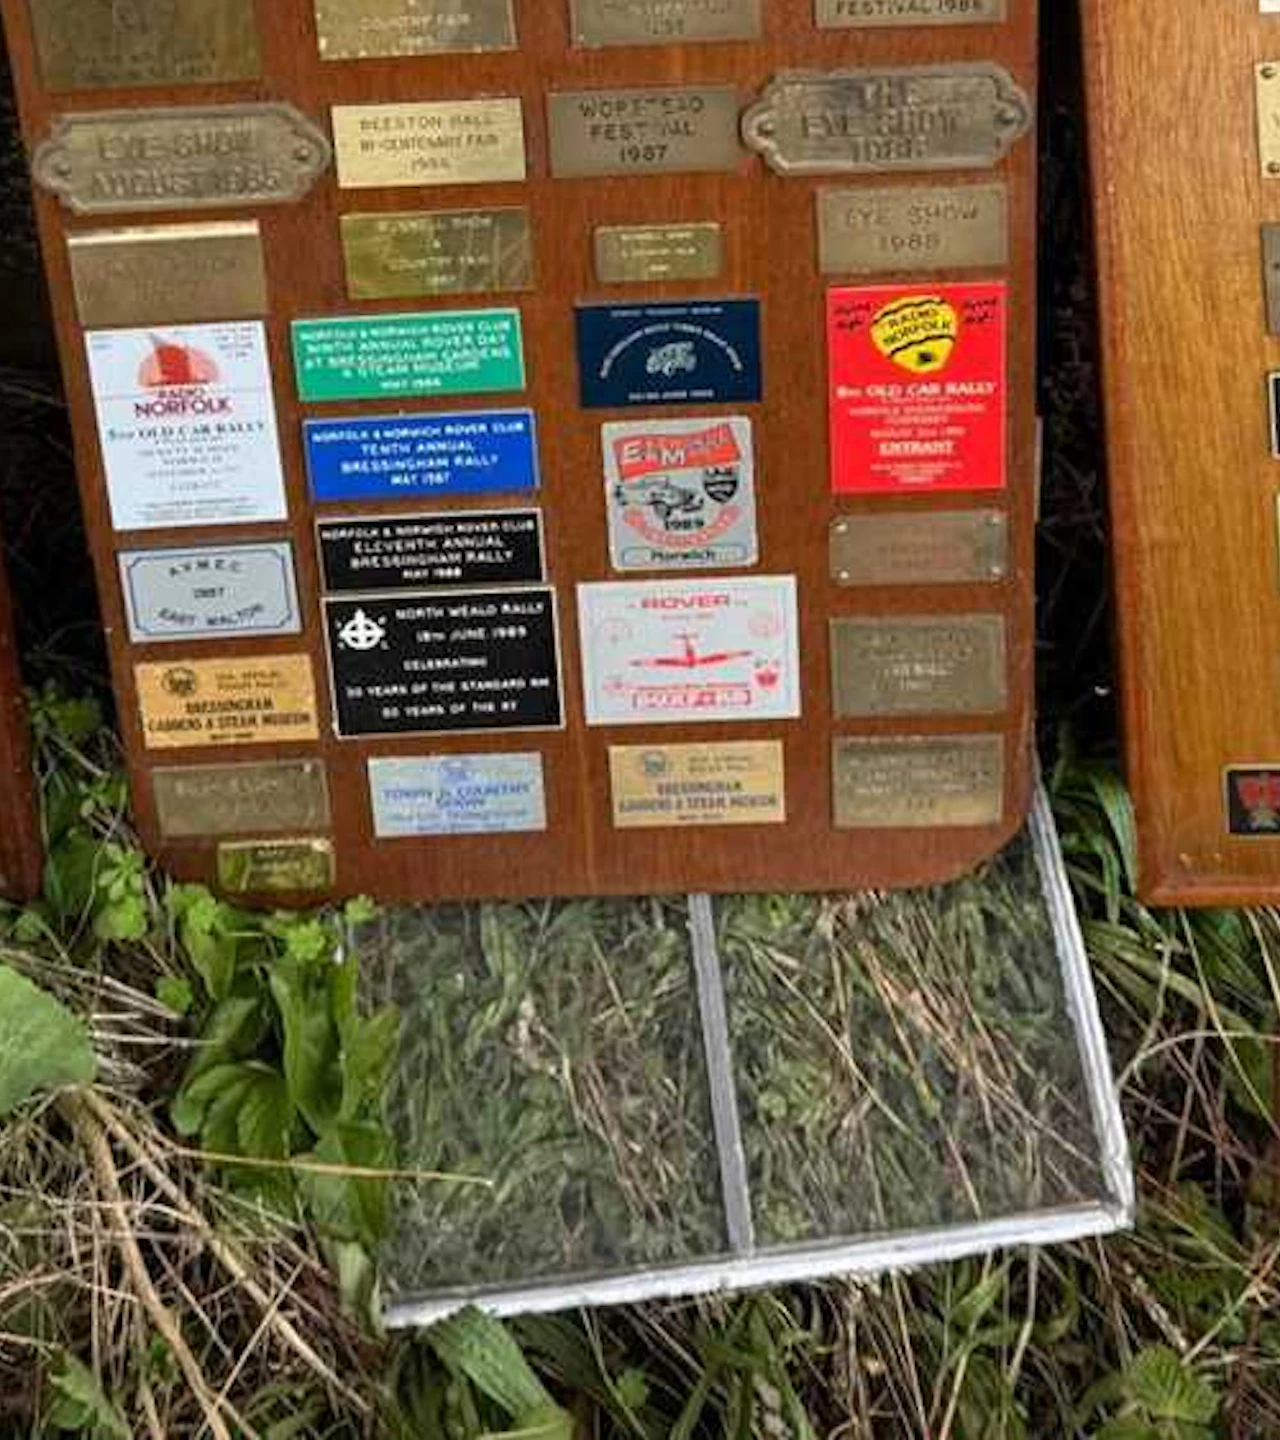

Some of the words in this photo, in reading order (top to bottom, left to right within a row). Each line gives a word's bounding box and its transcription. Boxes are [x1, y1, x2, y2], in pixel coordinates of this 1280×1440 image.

[580, 97, 705, 119] WORSTEAD
[618, 145, 669, 163] 1987
[134, 397, 235, 419] NORFOLK
[444, 424, 489, 436] ROVER
[361, 444, 411, 457] TENTH
[415, 441, 475, 453] ANNUAL
[880, 441, 955, 457] ENTRANT
[340, 458, 450, 475] BRESSINGHAM
[455, 455, 501, 469] RALLY
[501, 520, 535, 531] CLUB
[354, 539, 437, 553] ELEVENTH
[441, 536, 504, 549] ANNUAL
[465, 550, 513, 563] RALLY
[640, 595, 731, 610] ROVER
[396, 607, 445, 620] NORTH
[448, 604, 498, 618] WEALD
[501, 602, 546, 615] RALLY
[450, 627, 486, 641] JUNE
[366, 685, 408, 698] YEARS
[431, 682, 457, 694] THE
[404, 704, 446, 717] YEARS
